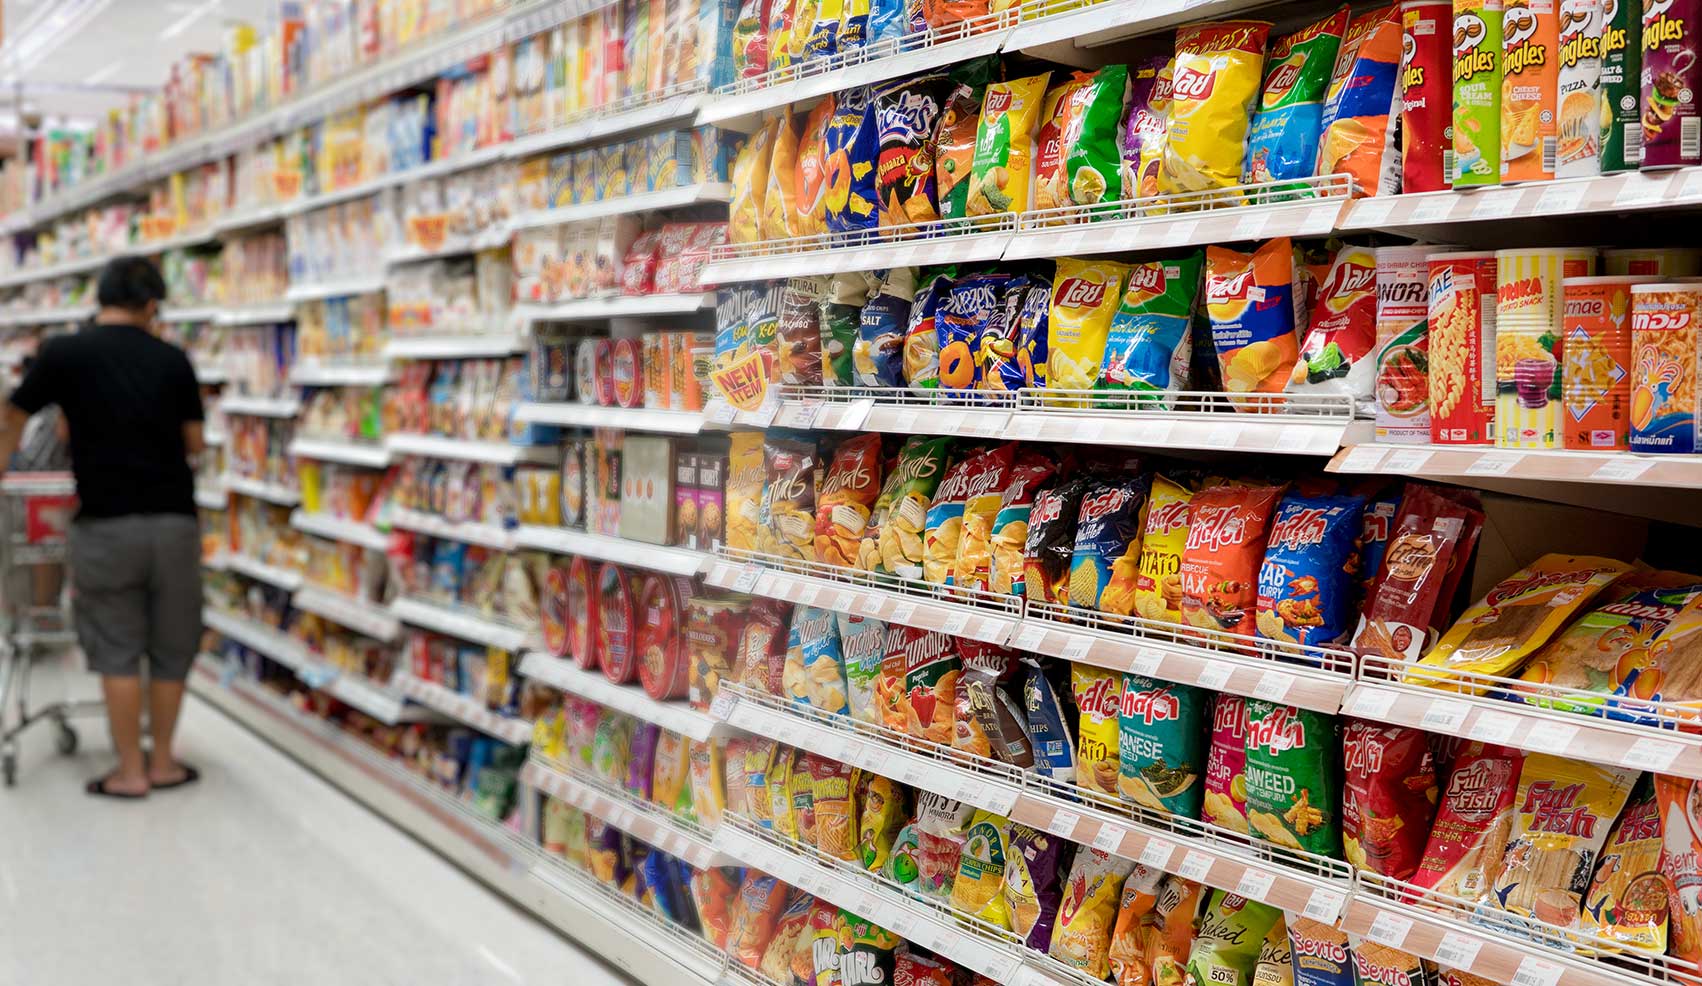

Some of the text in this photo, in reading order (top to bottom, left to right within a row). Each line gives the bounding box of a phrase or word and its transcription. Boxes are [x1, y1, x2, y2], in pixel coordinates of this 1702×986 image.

[1560, 80, 1587, 95] PIZZA
[861, 315, 882, 326] SALT
[717, 359, 758, 392] NEW
[730, 380, 762, 404] ITEM
[1258, 586, 1284, 600] CURRY
[1449, 766, 1489, 796] Full
[1456, 789, 1498, 813] Fish
[1521, 780, 1586, 814] Full
[1529, 806, 1598, 839] Fish
[1293, 929, 1347, 963] Bento
[1210, 971, 1235, 985] 50%
[1355, 951, 1411, 986] Bento
